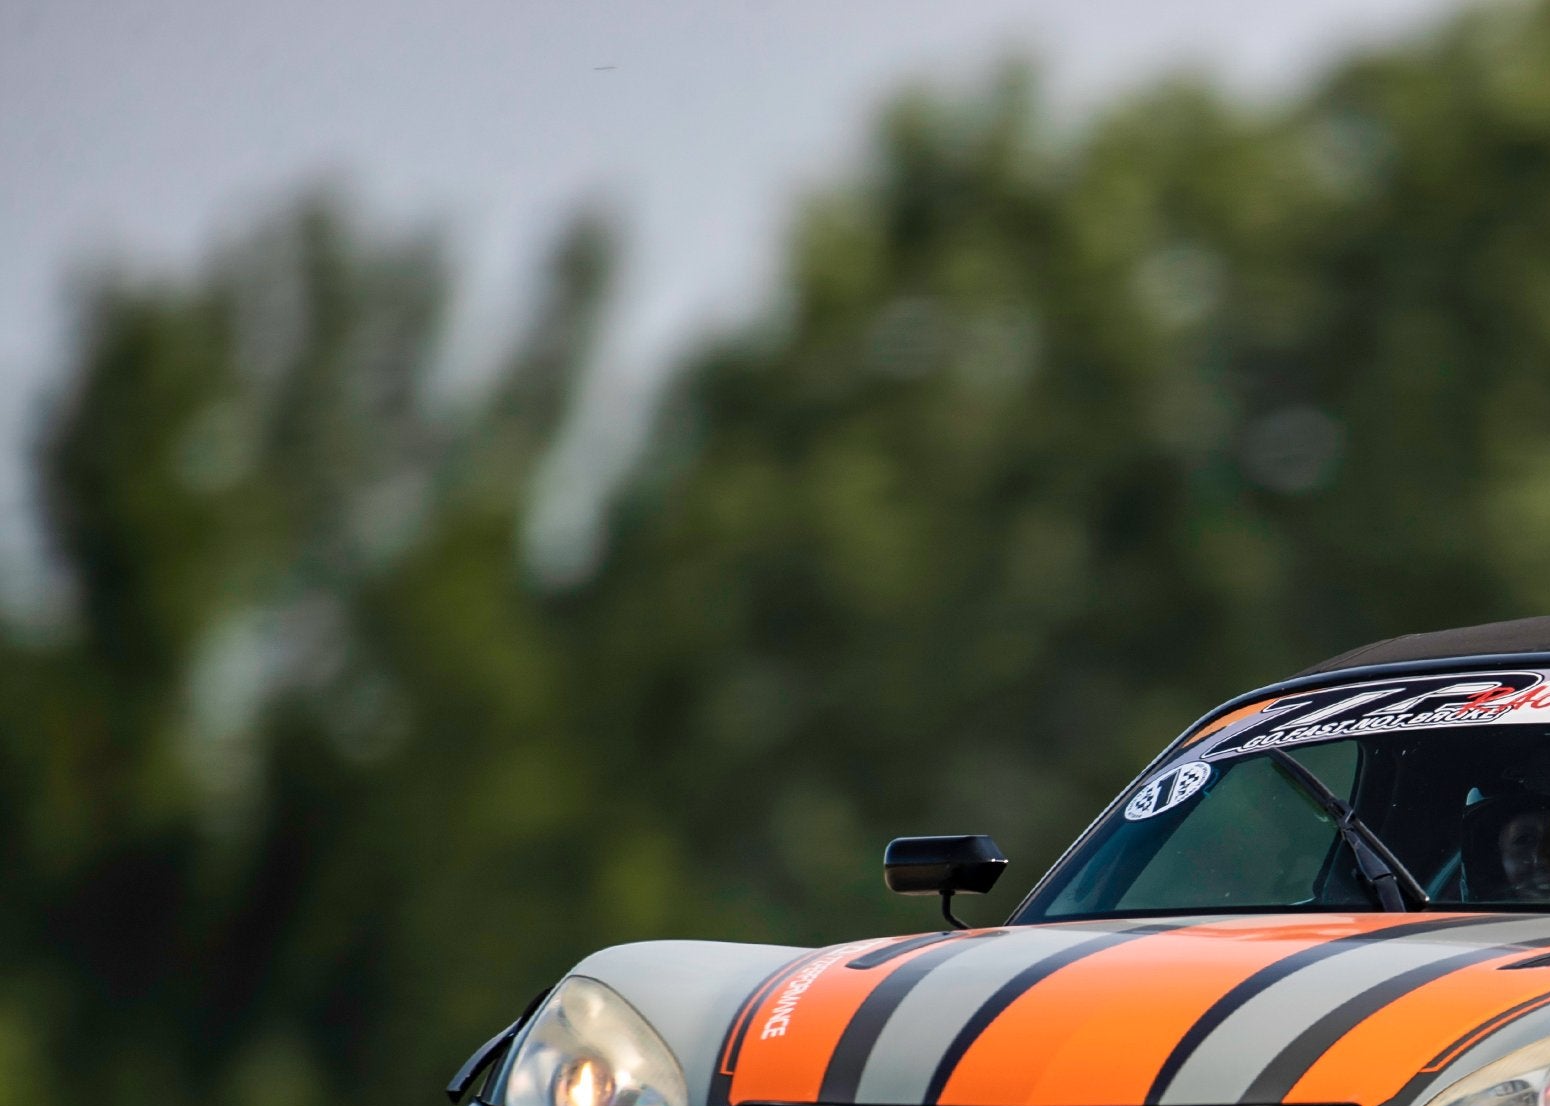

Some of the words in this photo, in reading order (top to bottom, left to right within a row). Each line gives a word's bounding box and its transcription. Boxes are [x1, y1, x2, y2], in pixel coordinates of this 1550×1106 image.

[1242, 731, 1285, 749] GO
[1282, 719, 1357, 741] FAST
[1350, 713, 1414, 731] NOT
